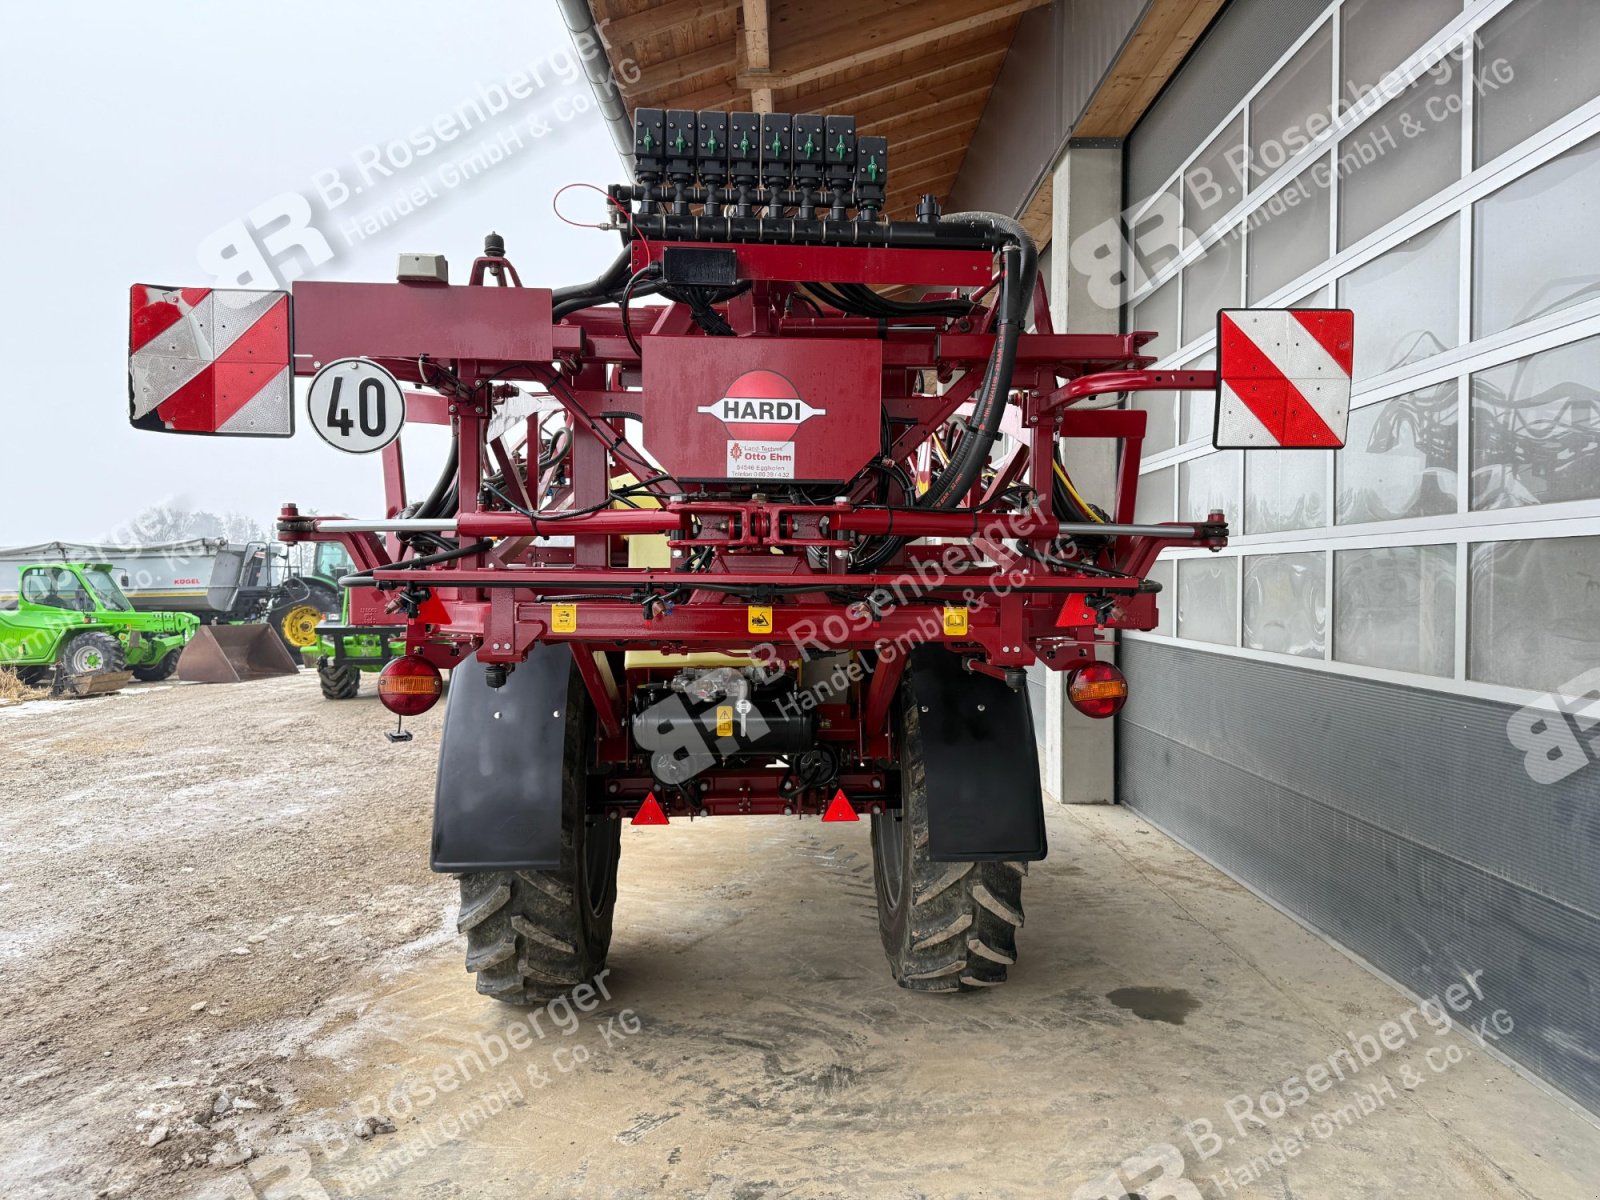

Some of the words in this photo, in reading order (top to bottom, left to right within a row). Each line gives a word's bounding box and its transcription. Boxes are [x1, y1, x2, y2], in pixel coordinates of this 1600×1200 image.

[327, 376, 386, 437] 40
[723, 400, 801, 420] HARDI
[744, 453, 767, 461] Otto
[769, 453, 792, 461] Ehm
